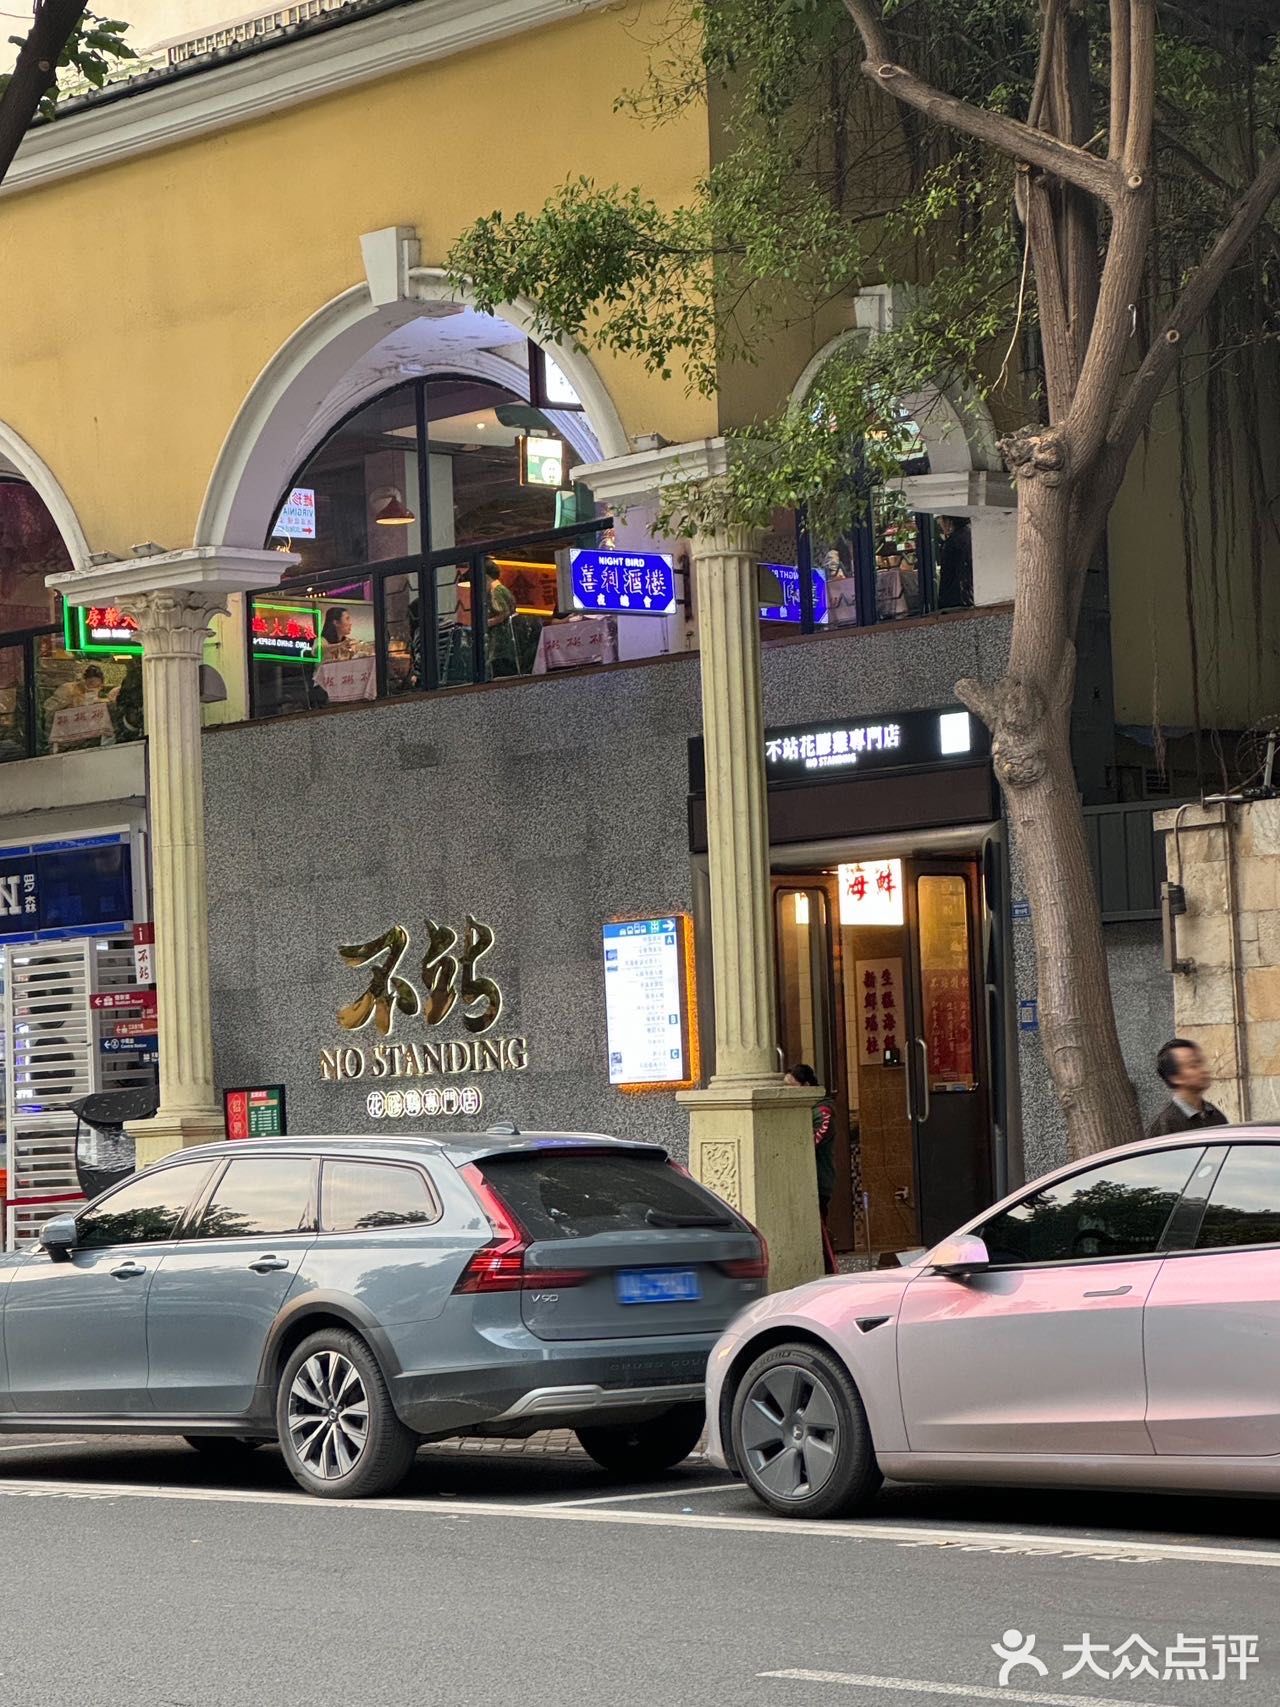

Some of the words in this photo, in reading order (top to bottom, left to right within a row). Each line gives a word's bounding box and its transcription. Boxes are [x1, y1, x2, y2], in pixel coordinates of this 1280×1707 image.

[598, 556, 624, 566] NIGHT
[624, 558, 645, 568] BIRD
[320, 1047, 364, 1080] NO
[371, 1037, 528, 1078] STANDING
[531, 1294, 559, 1303] V90
